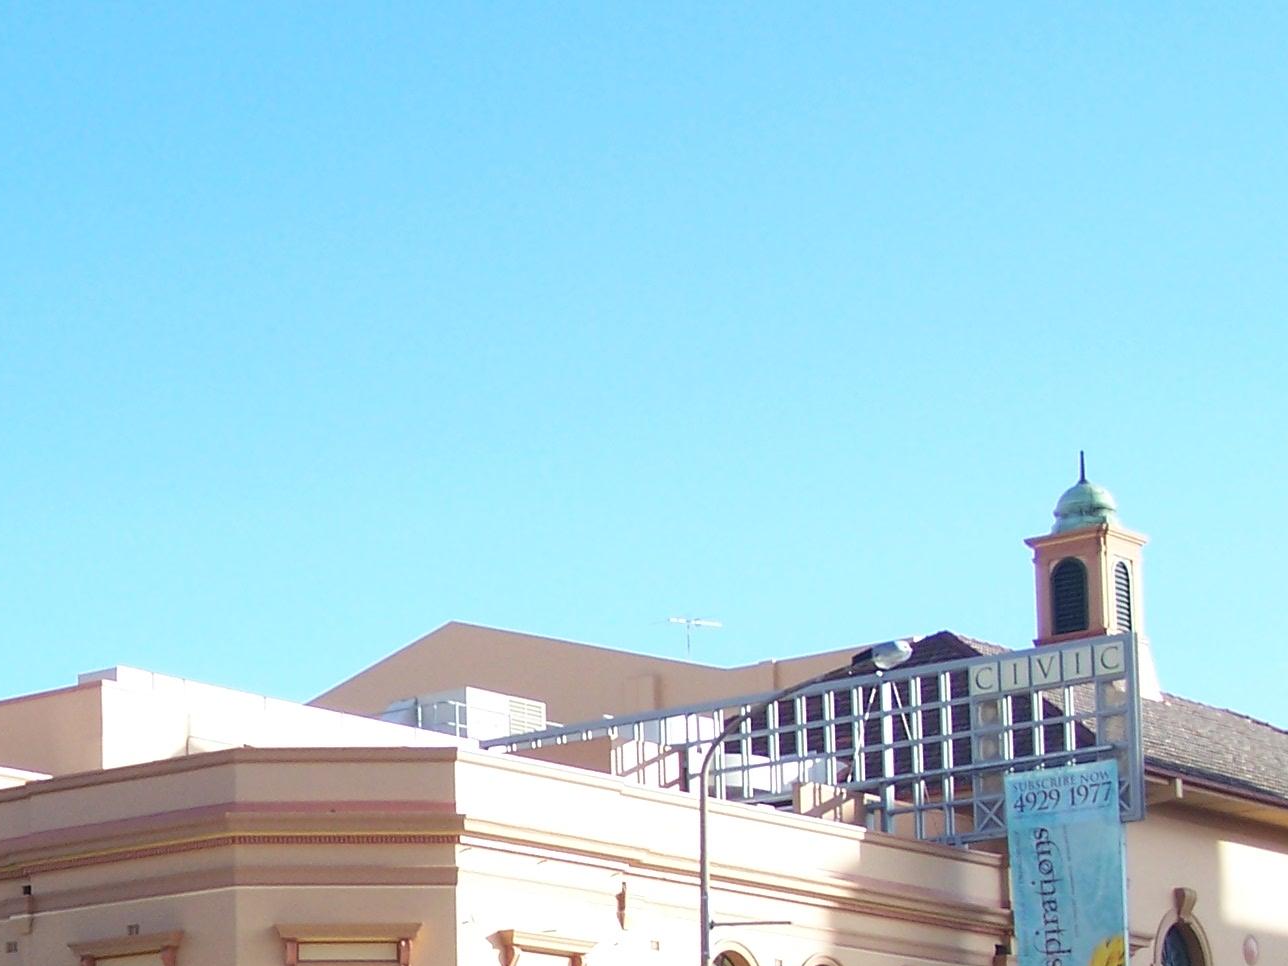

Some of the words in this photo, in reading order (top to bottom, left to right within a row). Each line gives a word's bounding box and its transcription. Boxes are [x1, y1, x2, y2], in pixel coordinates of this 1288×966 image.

[975, 645, 1120, 690] CIVIC
[1013, 776, 1076, 792] SUBSCRIBE
[1080, 770, 1110, 783] NOW
[1013, 788, 1061, 812] 4929
[1070, 781, 1112, 806] 1977
